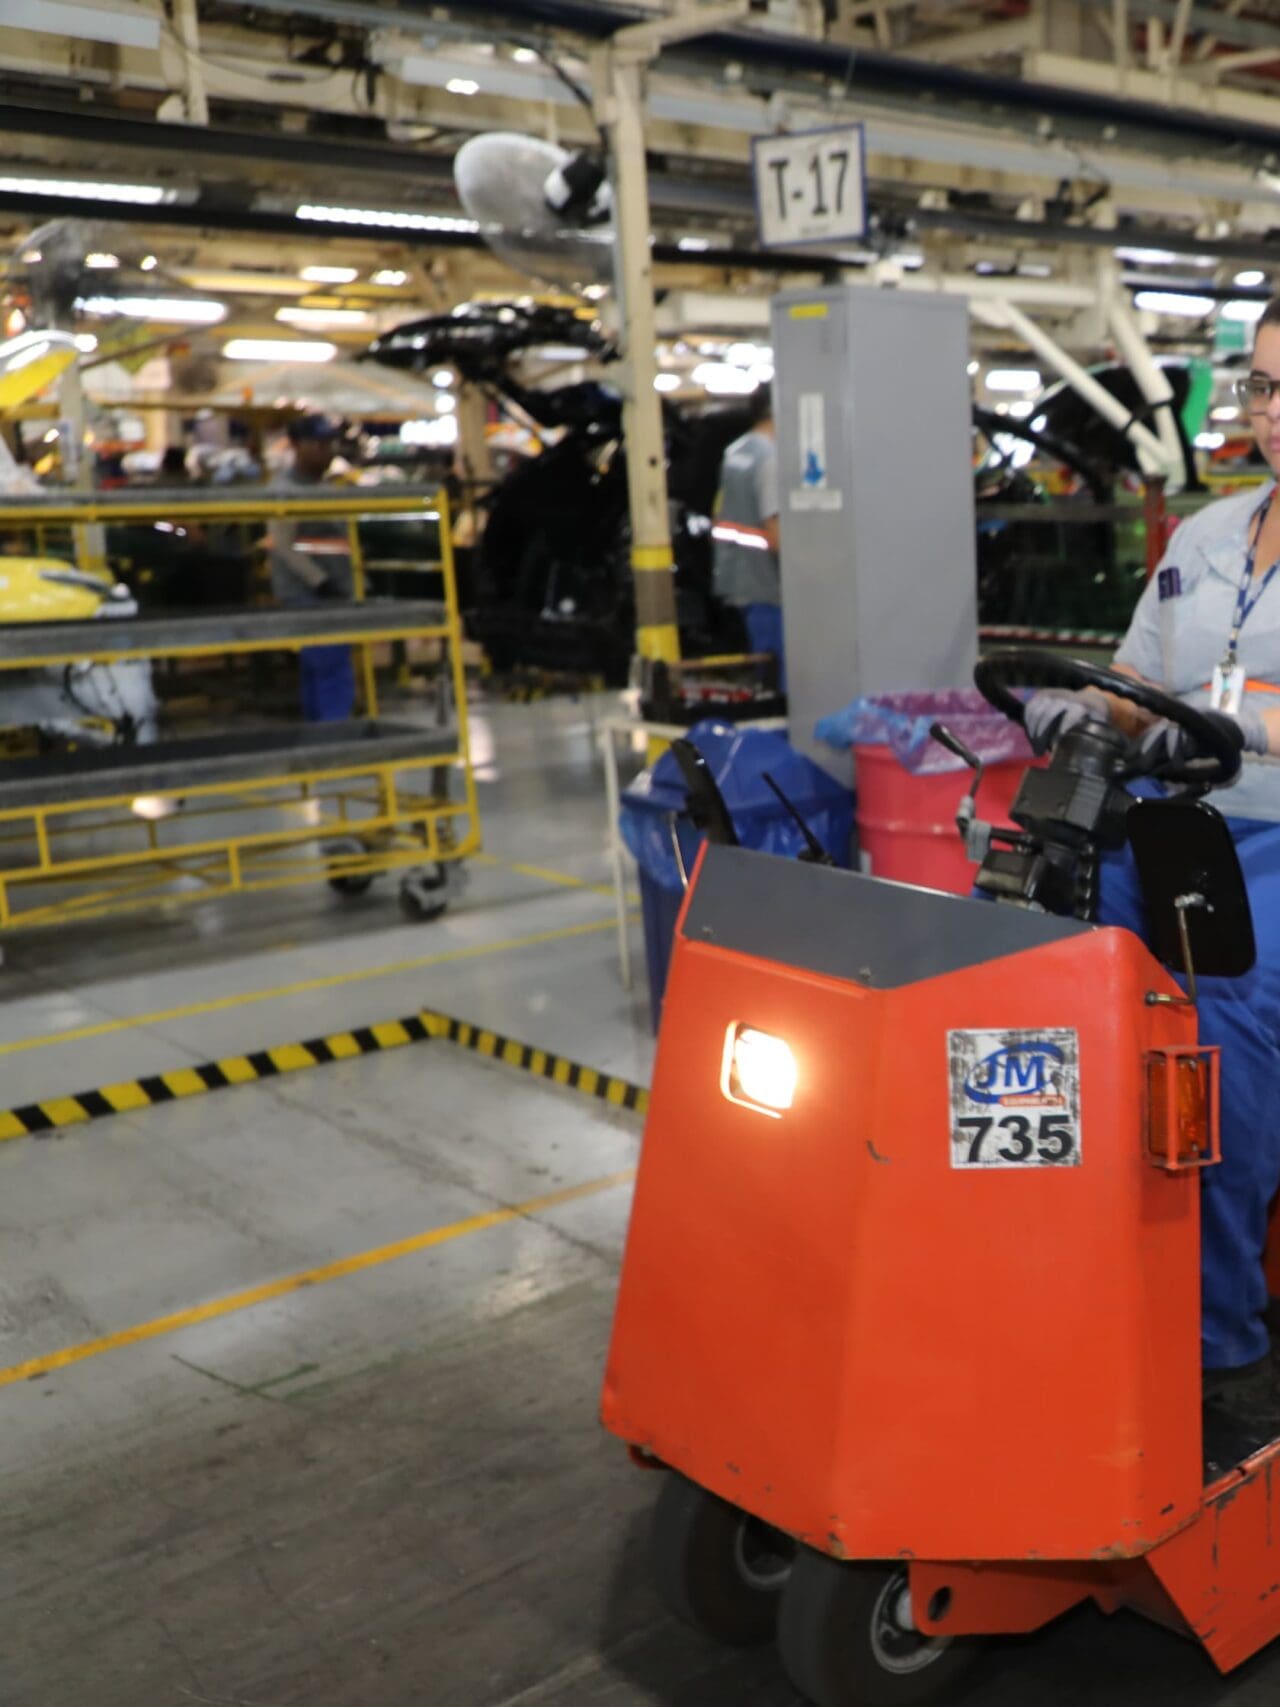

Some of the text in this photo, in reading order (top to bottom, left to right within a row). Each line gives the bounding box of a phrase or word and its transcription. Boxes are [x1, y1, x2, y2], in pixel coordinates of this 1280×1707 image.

[768, 151, 848, 219] T-17
[974, 1055, 1045, 1088] JM
[958, 1114, 1074, 1163] 735
